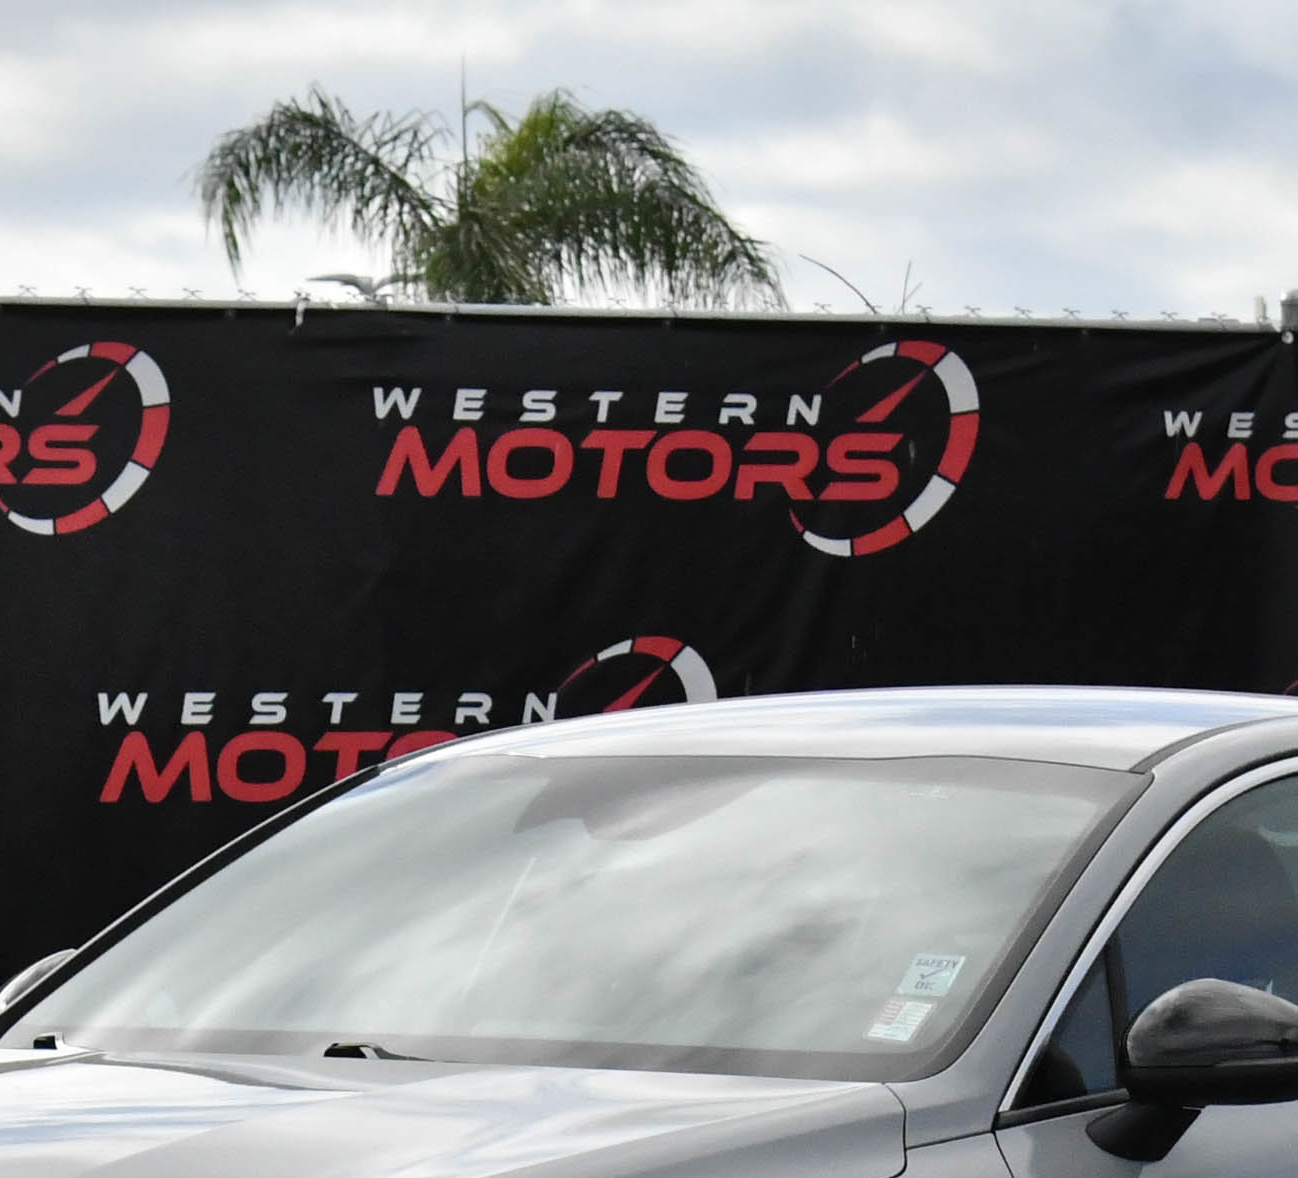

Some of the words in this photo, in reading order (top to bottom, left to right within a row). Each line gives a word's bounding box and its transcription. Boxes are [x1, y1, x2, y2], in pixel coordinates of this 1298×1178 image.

[373, 387, 822, 426] WESTERN
[376, 425, 903, 502] MOTORS
[97, 692, 559, 726] WESTERN
